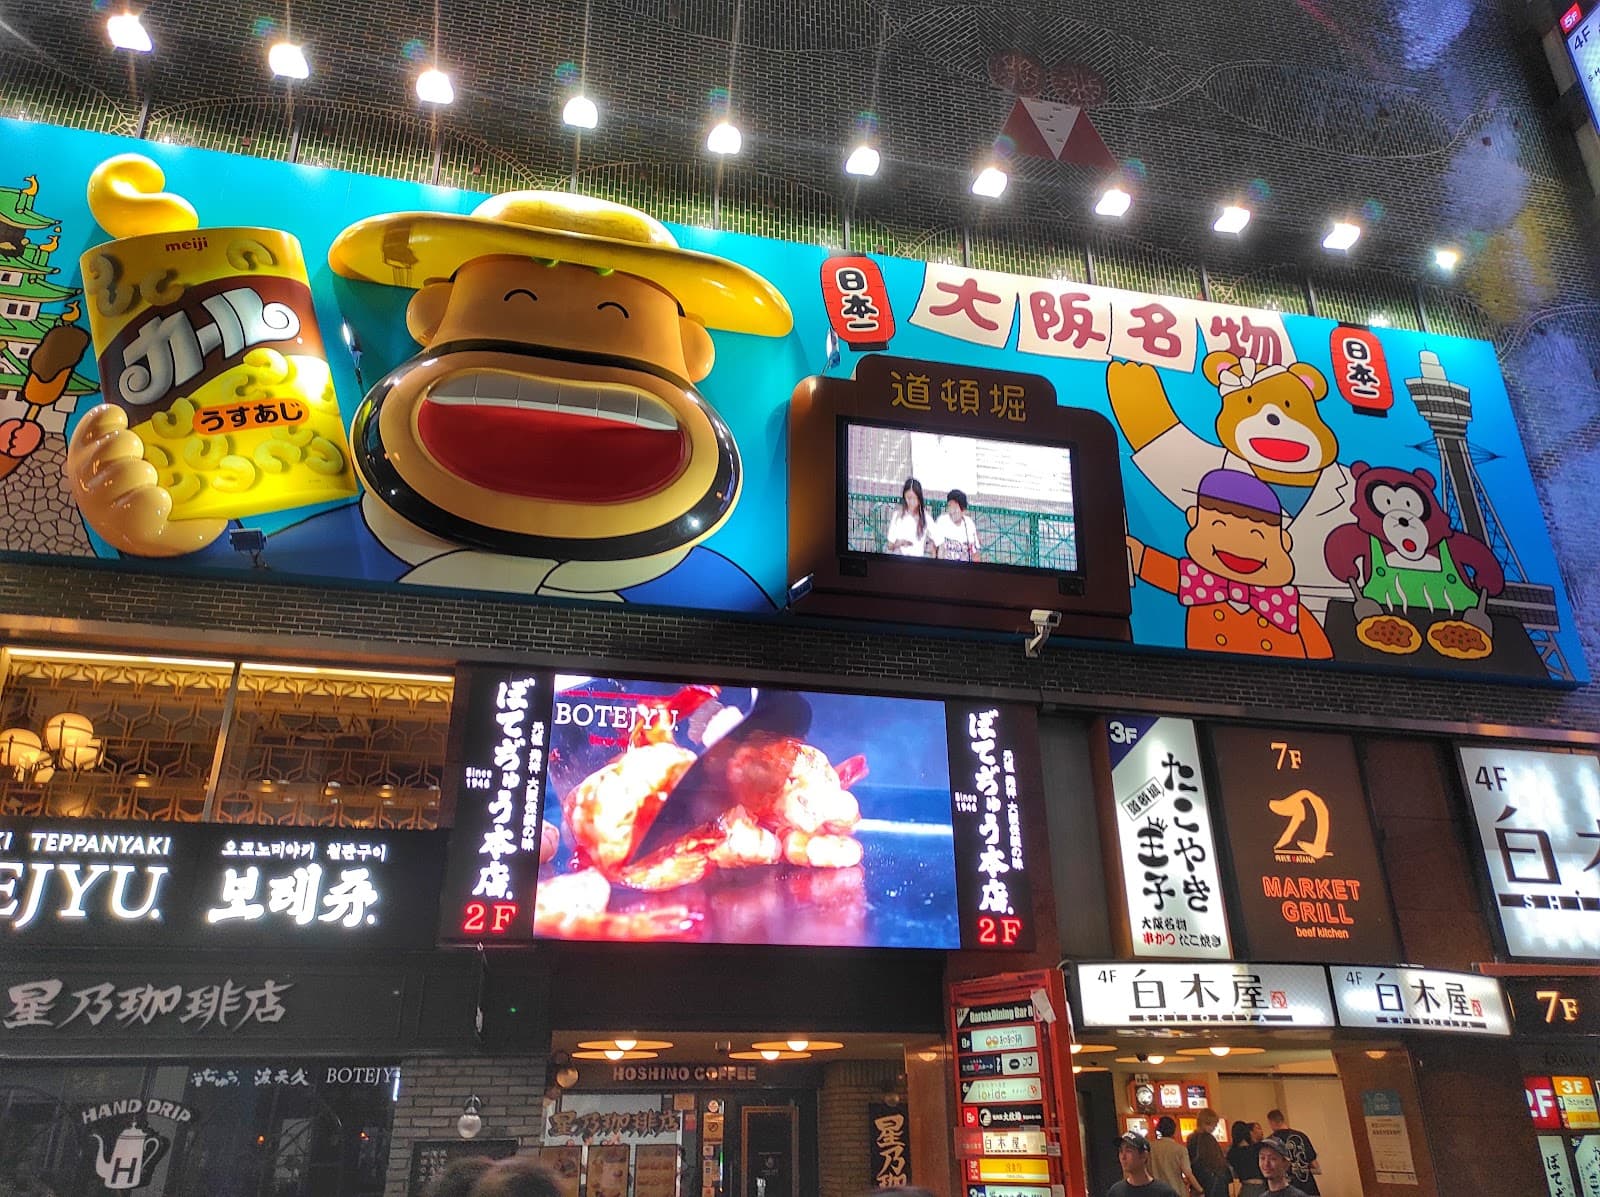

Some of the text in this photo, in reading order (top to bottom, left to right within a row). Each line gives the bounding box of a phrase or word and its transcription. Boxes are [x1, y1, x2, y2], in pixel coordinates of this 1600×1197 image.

[1574, 25, 1591, 50] 4F
[165, 237, 209, 252] meiji
[837, 268, 879, 331] 日本一
[929, 278, 1284, 366] 大阪名物
[118, 287, 301, 405] カール
[1345, 341, 1379, 395] 日本一
[890, 370, 1027, 422] 道頓堀
[201, 402, 303, 432] うすあじ
[1109, 721, 1138, 744] 3F
[1270, 742, 1302, 770] 7F
[1475, 766, 1508, 791] 4F
[1161, 752, 1211, 913] たこやき
[1268, 789, 1334, 859] 刀
[30, 833, 171, 855] TEPPANYAKI
[1262, 876, 1360, 900] MARKET
[464, 903, 516, 931] 2F
[1142, 917, 1187, 931] 大阪名物
[1282, 901, 1354, 924] GRILL
[978, 918, 1021, 944] 2F
[1143, 932, 1221, 948] 串かつ たこ焼き
[1296, 926, 1349, 939] beef kitchen
[1098, 970, 1117, 983] 4F
[1132, 968, 1269, 1010] 白木屋
[1346, 971, 1362, 986] 4F
[3, 979, 293, 1031] 星乃珈琲店
[1375, 972, 1473, 1018] 白木屋
[1536, 990, 1580, 1023] 7F
[613, 1064, 758, 1082] HOSHINO COFFEE
[1561, 1080, 1584, 1094] 3F
[82, 1099, 191, 1124] HAND DRIP
[549, 1109, 680, 1137] 星乃珈琲店
[111, 1157, 137, 1184] H
